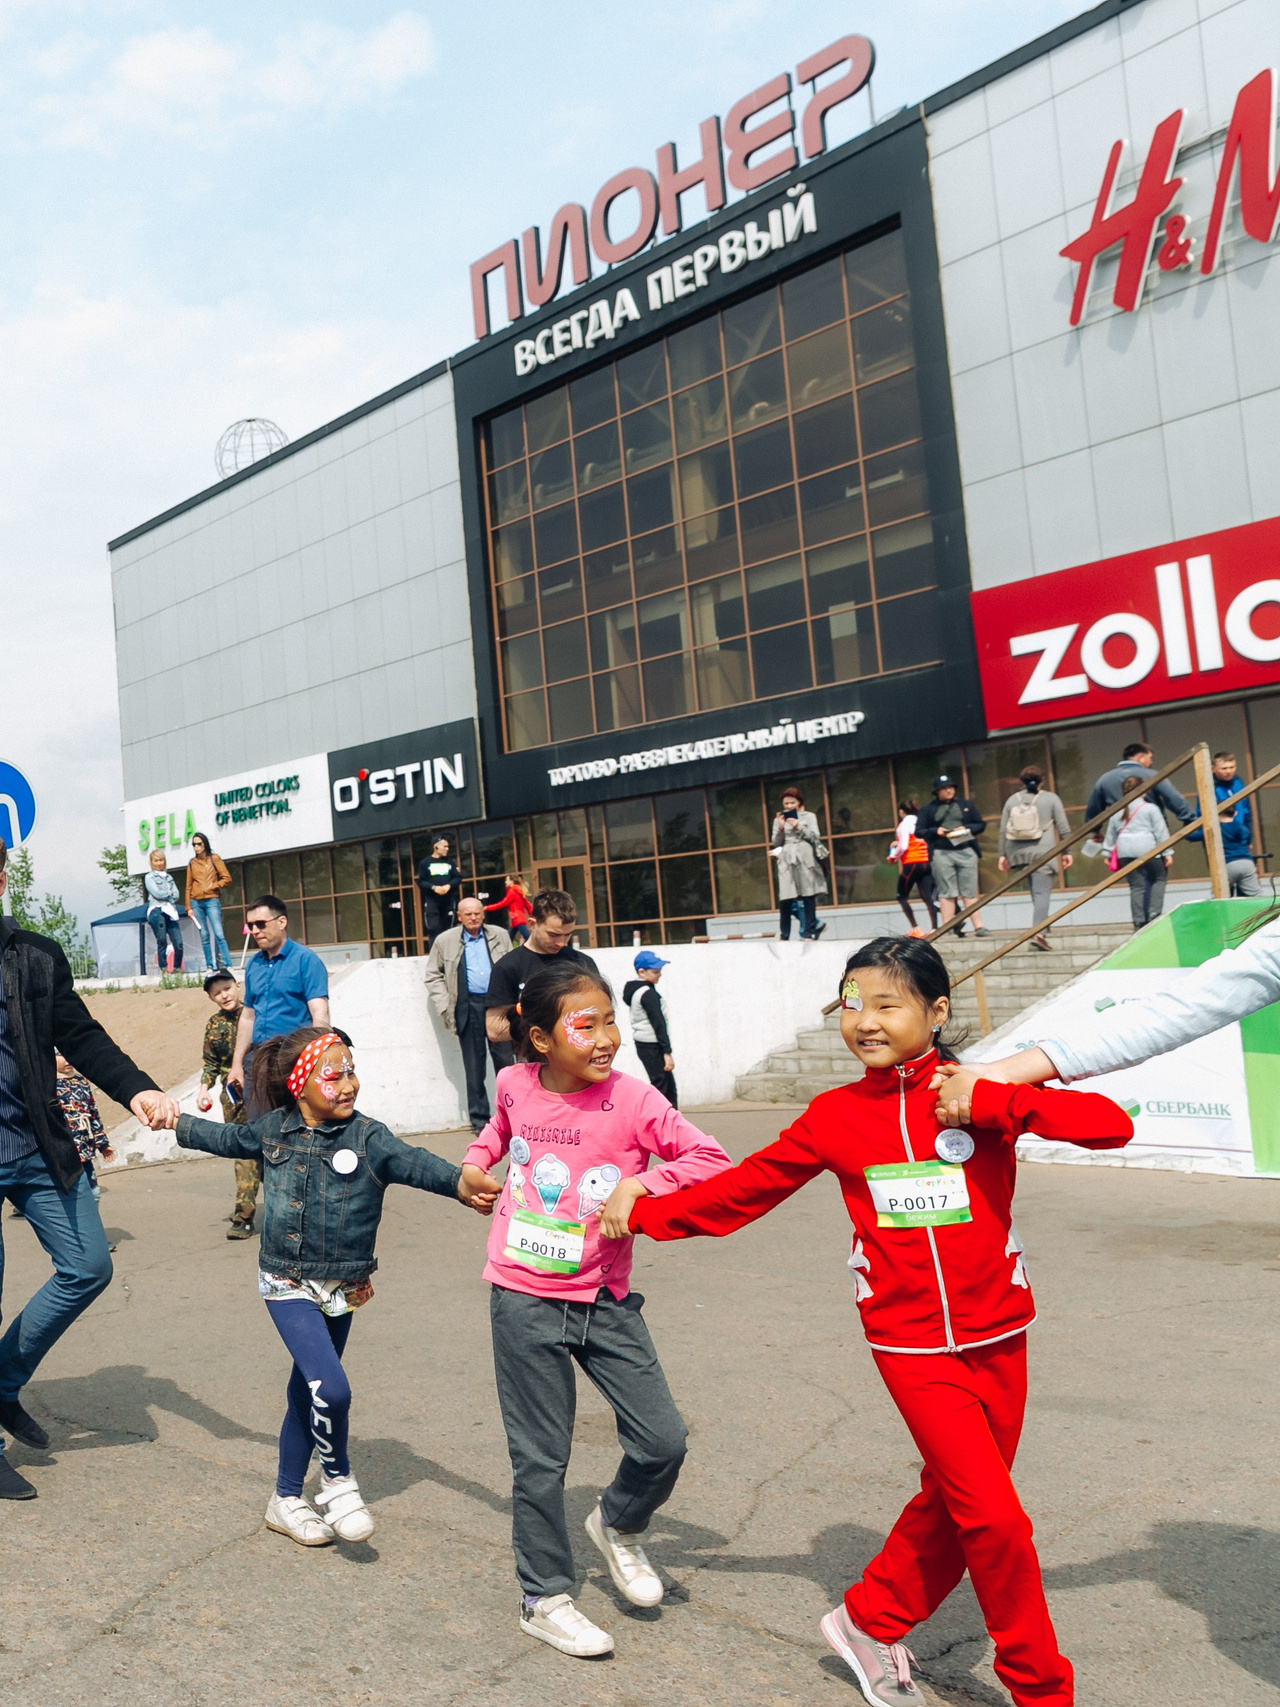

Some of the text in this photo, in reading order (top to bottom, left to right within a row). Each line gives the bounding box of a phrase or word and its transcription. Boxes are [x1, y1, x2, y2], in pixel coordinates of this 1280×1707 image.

[470, 34, 875, 340] ПИОНЕР
[514, 182, 817, 376] ВСЕГДА ПЕРВЫЙ
[547, 711, 865, 786] ТОРГОВО-РАЗВЛЕКАТЕЛЬНЫЙ ЦЕНТР
[214, 775, 300, 807] UNITED COLORS
[333, 753, 465, 812] O'STIN
[138, 809, 197, 851] SELA
[215, 811, 230, 826] OF
[1146, 1100, 1232, 1117] СБЕРБАНК
